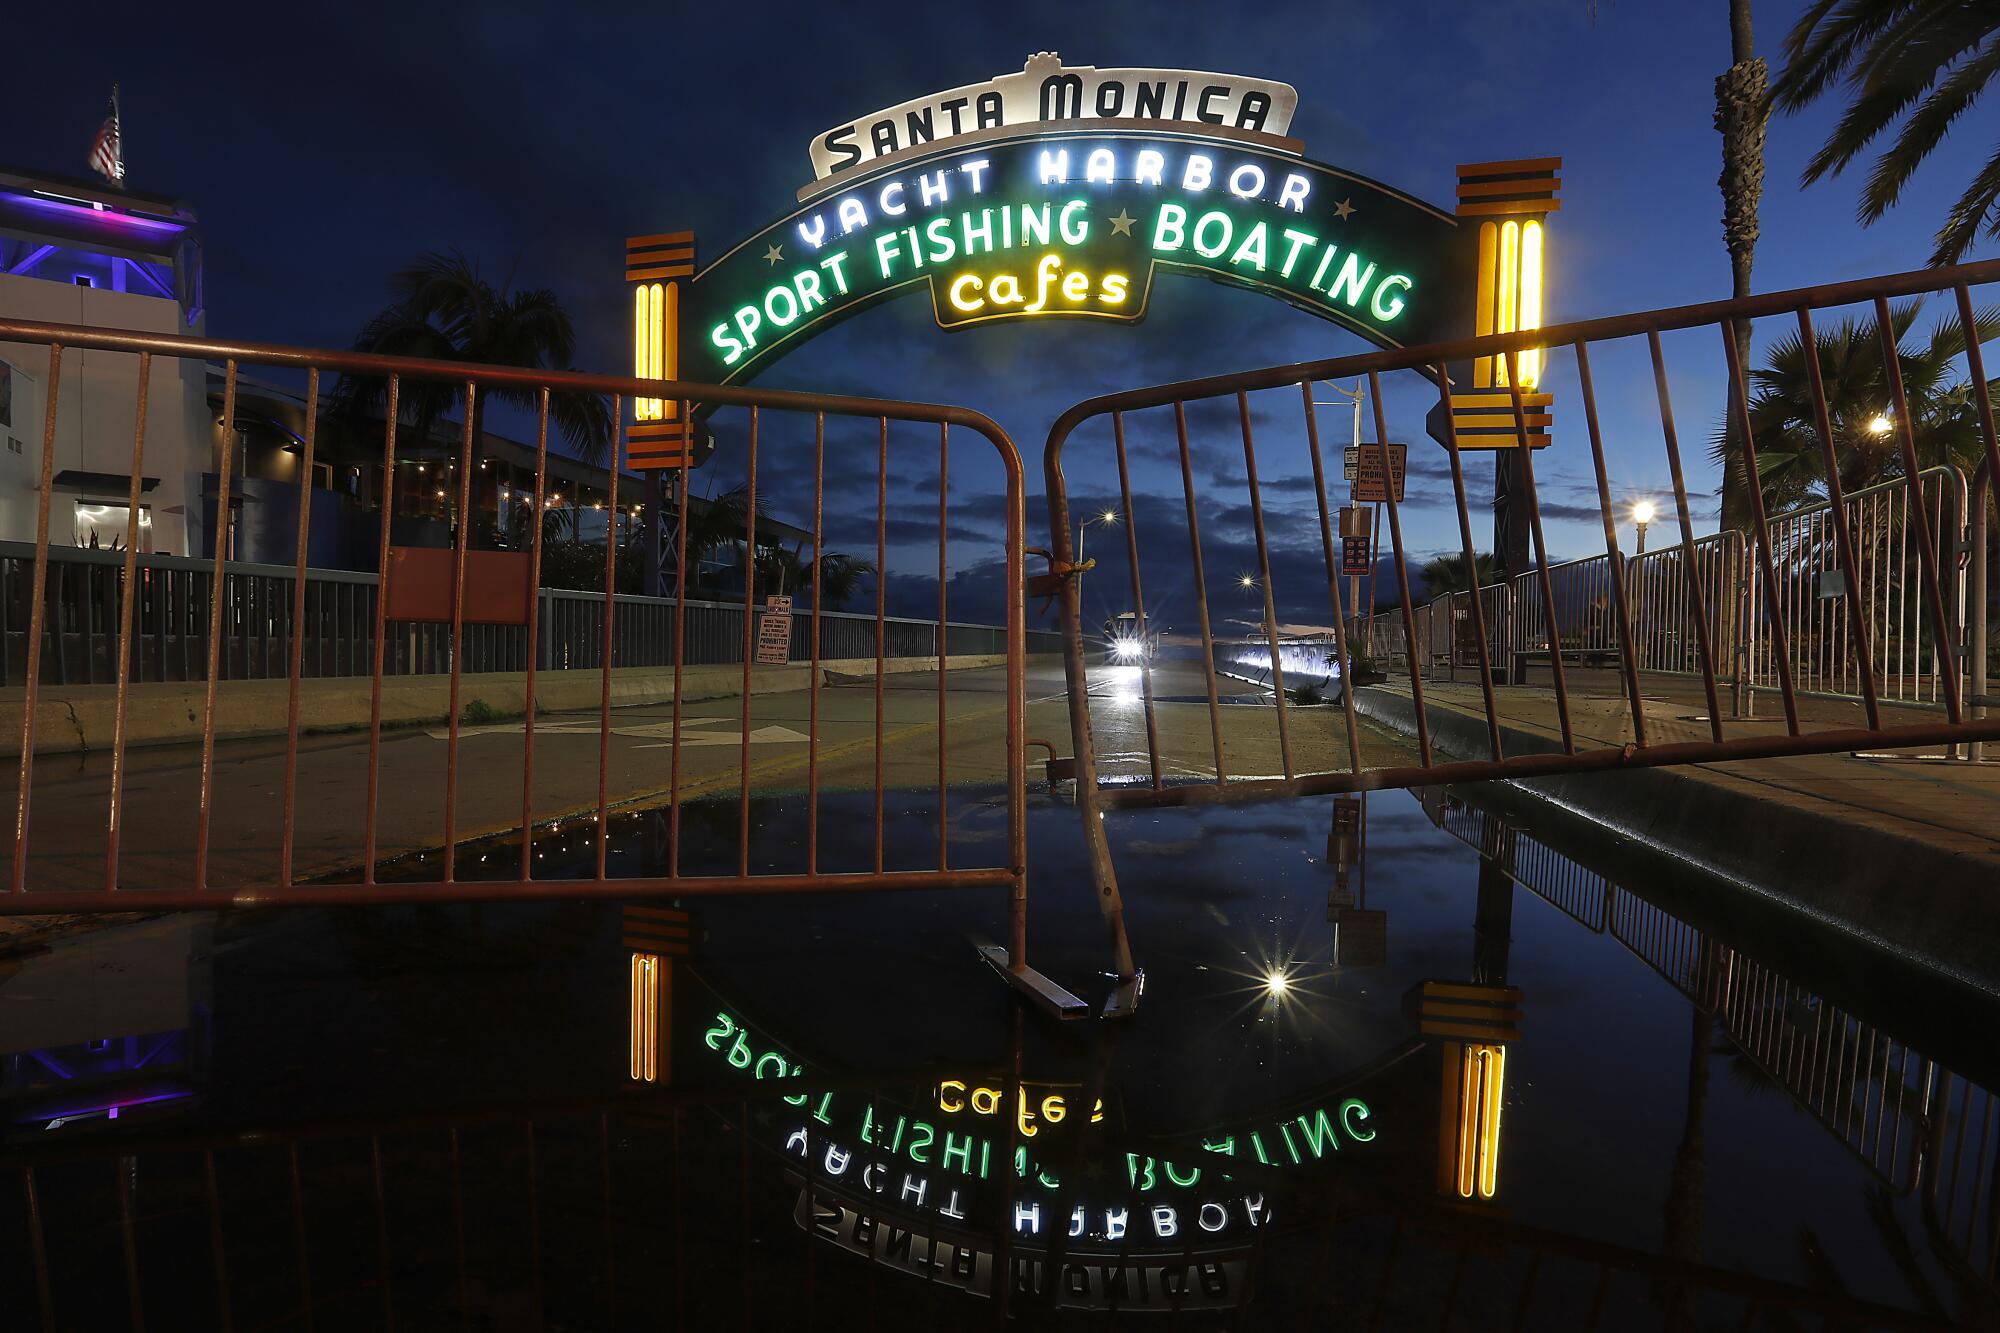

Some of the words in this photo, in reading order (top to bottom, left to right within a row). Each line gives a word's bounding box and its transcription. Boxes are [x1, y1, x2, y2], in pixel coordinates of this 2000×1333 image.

[824, 91, 1003, 173] SANTA
[1040, 74, 1272, 131] MONICA
[798, 160, 990, 249] YACHT
[1039, 148, 1311, 214] HARBOR
[711, 250, 849, 366] SPORT
[875, 199, 1090, 279] FISHING
[1152, 203, 1413, 322] BOATING
[950, 254, 1130, 312] cafes
